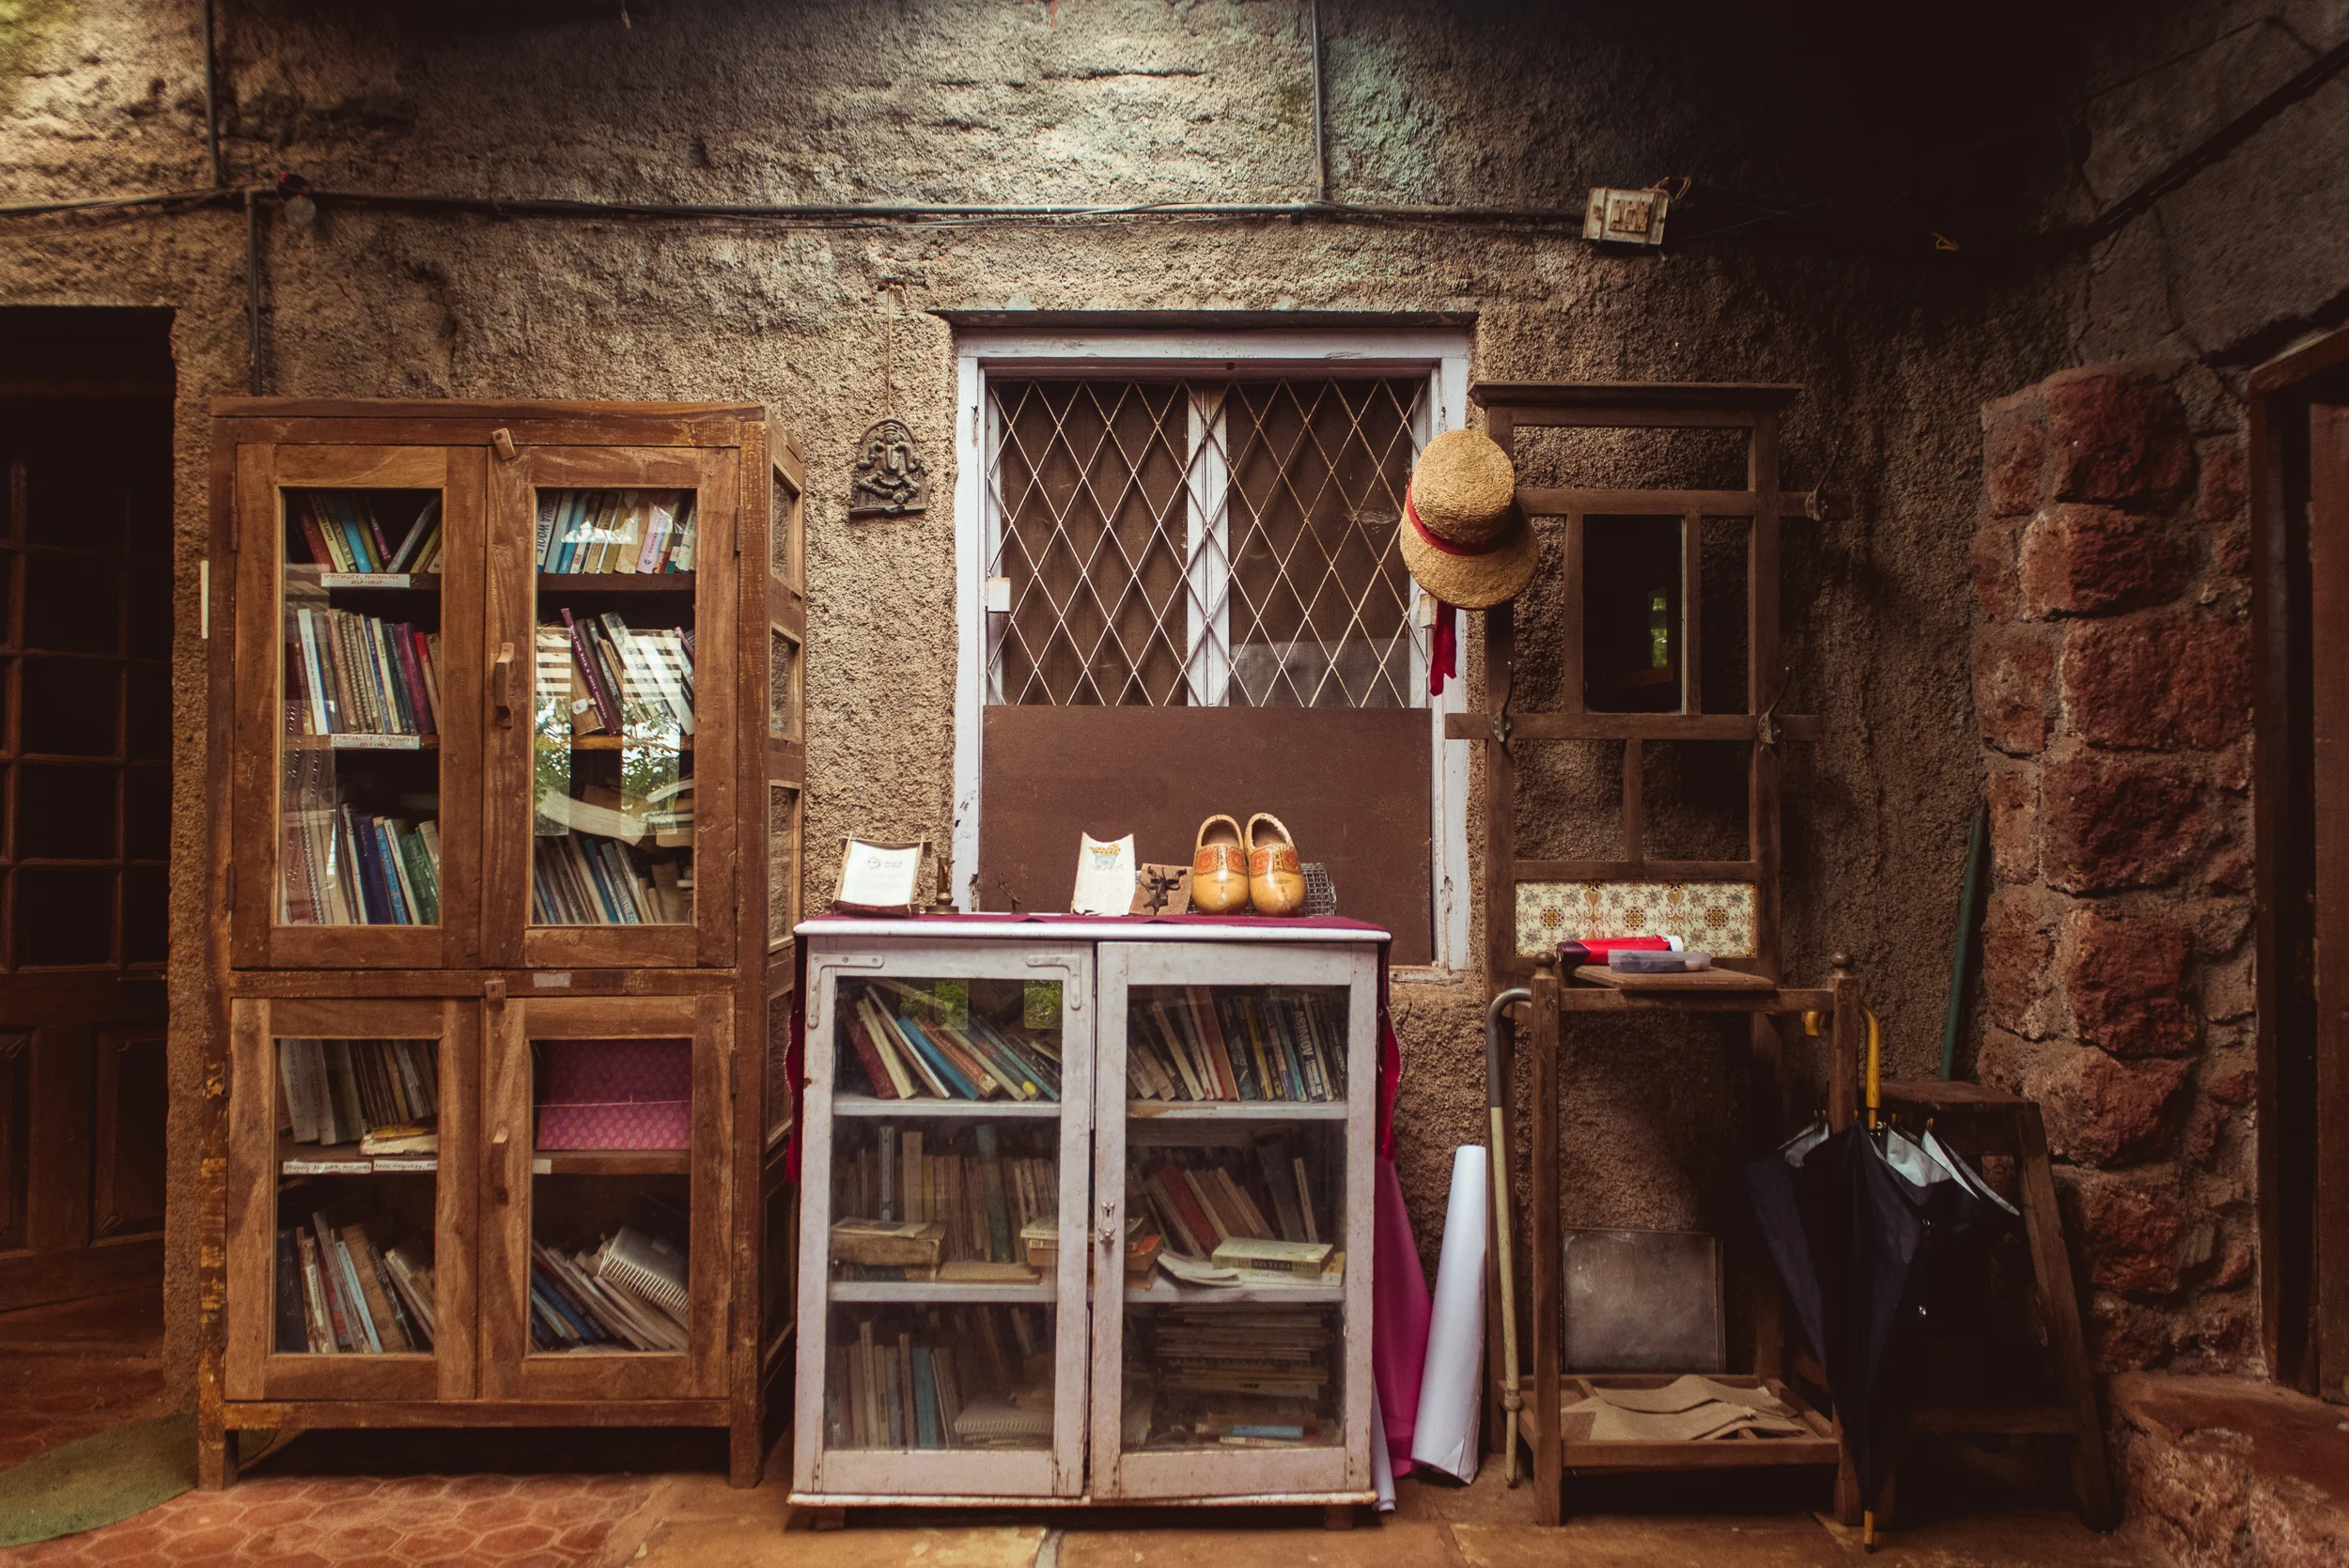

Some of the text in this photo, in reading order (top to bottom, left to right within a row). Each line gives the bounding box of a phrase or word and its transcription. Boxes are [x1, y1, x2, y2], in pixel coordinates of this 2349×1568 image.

[322, 522, 334, 542] LIGHT
[647, 532, 658, 554] KRISHNA
[1293, 1009, 1313, 1056] ASIMOV
[1304, 1061, 1316, 1096] FOUNDATION
